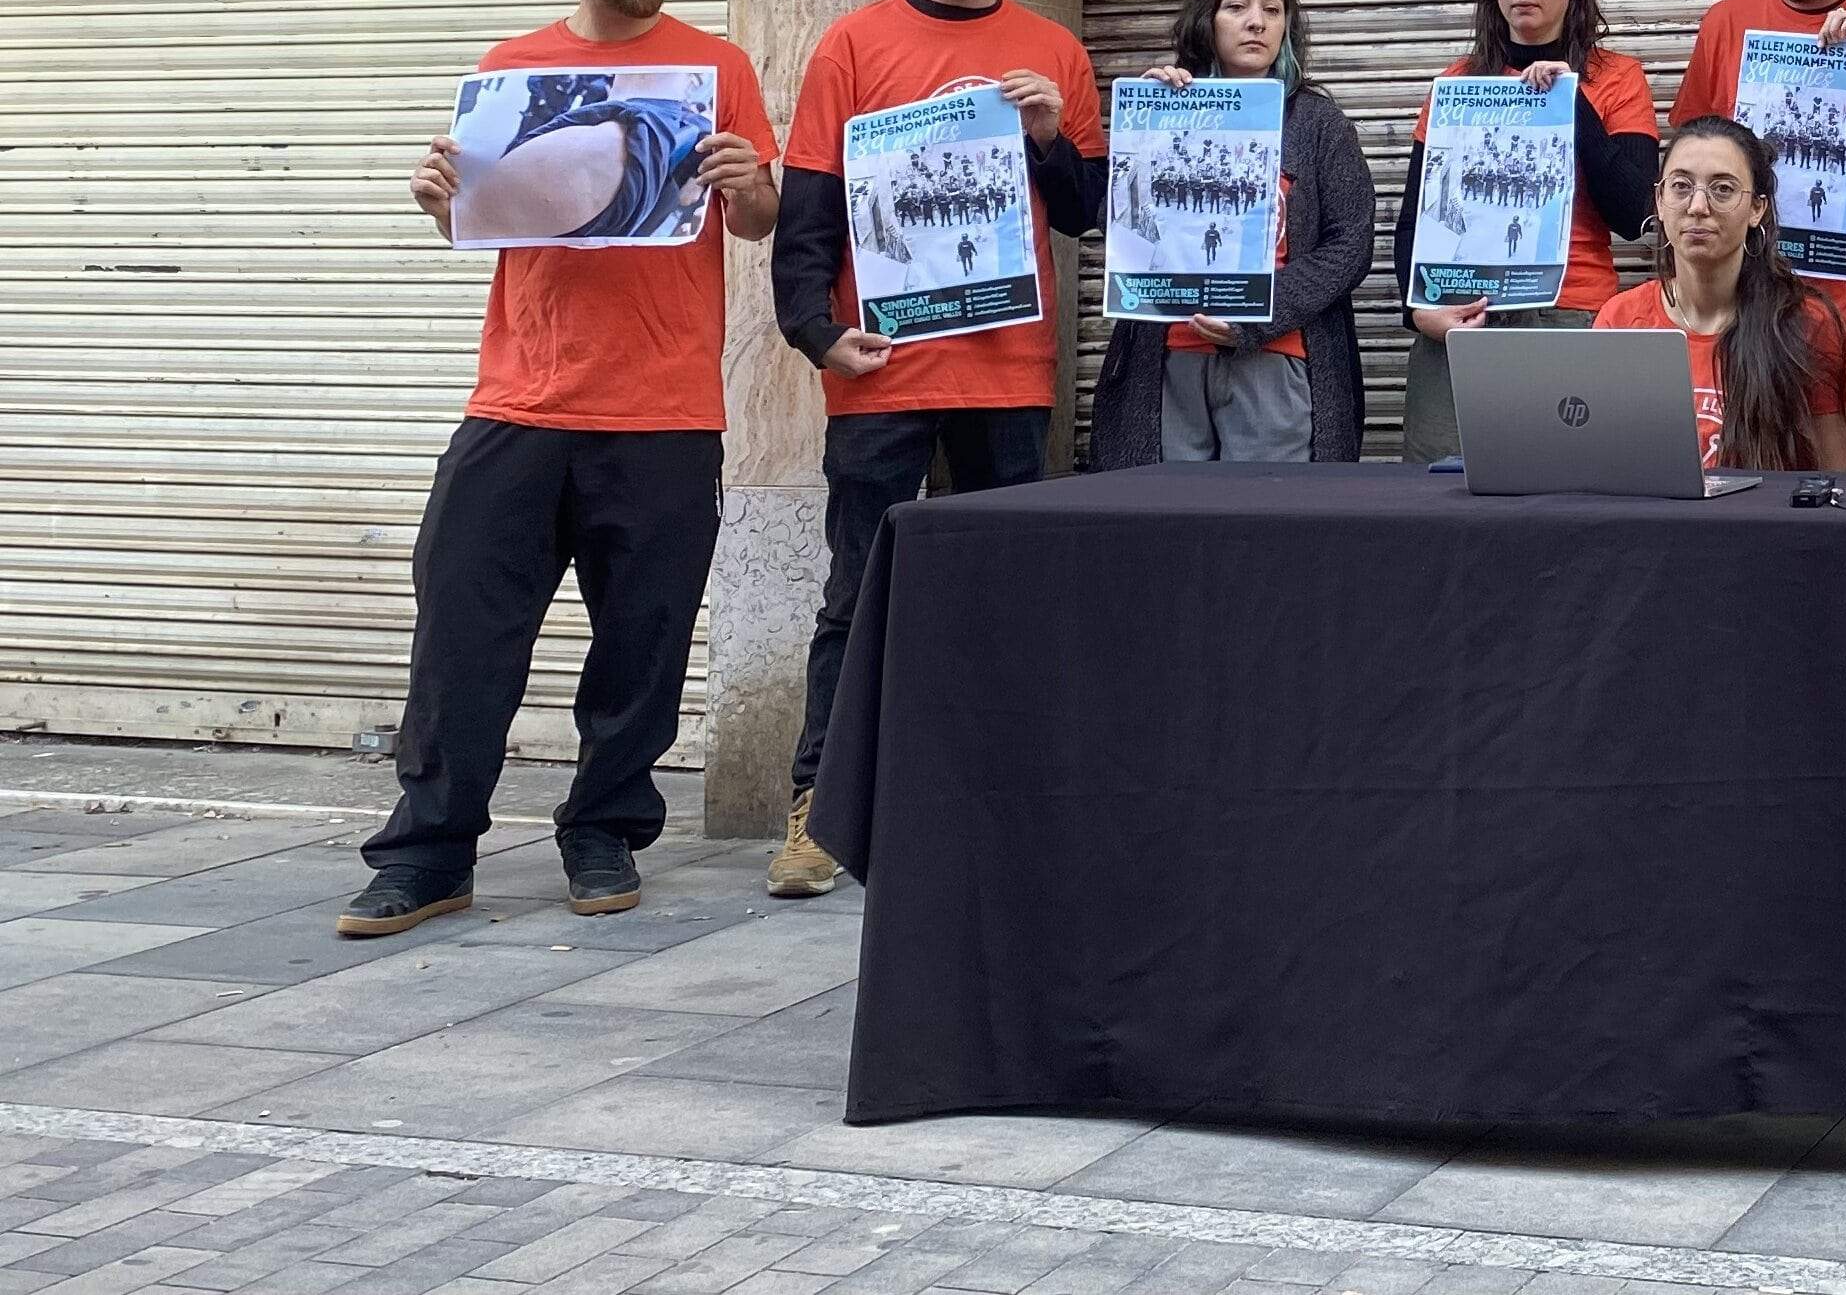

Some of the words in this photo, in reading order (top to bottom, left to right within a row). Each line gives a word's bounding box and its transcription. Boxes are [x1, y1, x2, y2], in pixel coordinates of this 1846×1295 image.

[1748, 40, 1760, 50] NI
[1761, 41, 1785, 51] LLEI
[1745, 60, 1770, 83] 89
[1119, 87, 1134, 99] NI
[1137, 87, 1166, 99] LLEI
[1169, 87, 1242, 99] MORDASSA
[1438, 85, 1451, 96] NI
[1454, 85, 1481, 96] LLEI
[1136, 100, 1242, 112] DESNONAMENTS
[1453, 97, 1547, 108] DESNONAMENTS
[852, 121, 867, 133] NI
[870, 114, 899, 129] LLEI
[901, 96, 976, 122] MORDASSA
[1120, 108, 1151, 131] 89
[1436, 104, 1466, 128] 89
[870, 109, 976, 140] DESNONAMENTS
[856, 135, 885, 159] 89
[1776, 240, 1805, 252] TERES
[1430, 268, 1476, 279] SINDICAT
[1125, 277, 1173, 288] SINDICAT
[1440, 278, 1500, 290] LLOGATERES
[1138, 288, 1200, 298] LLOGATERES
[881, 295, 930, 312] SINDICAT
[895, 300, 962, 320] LLOGATERES
[1562, 396, 1586, 426] hp
